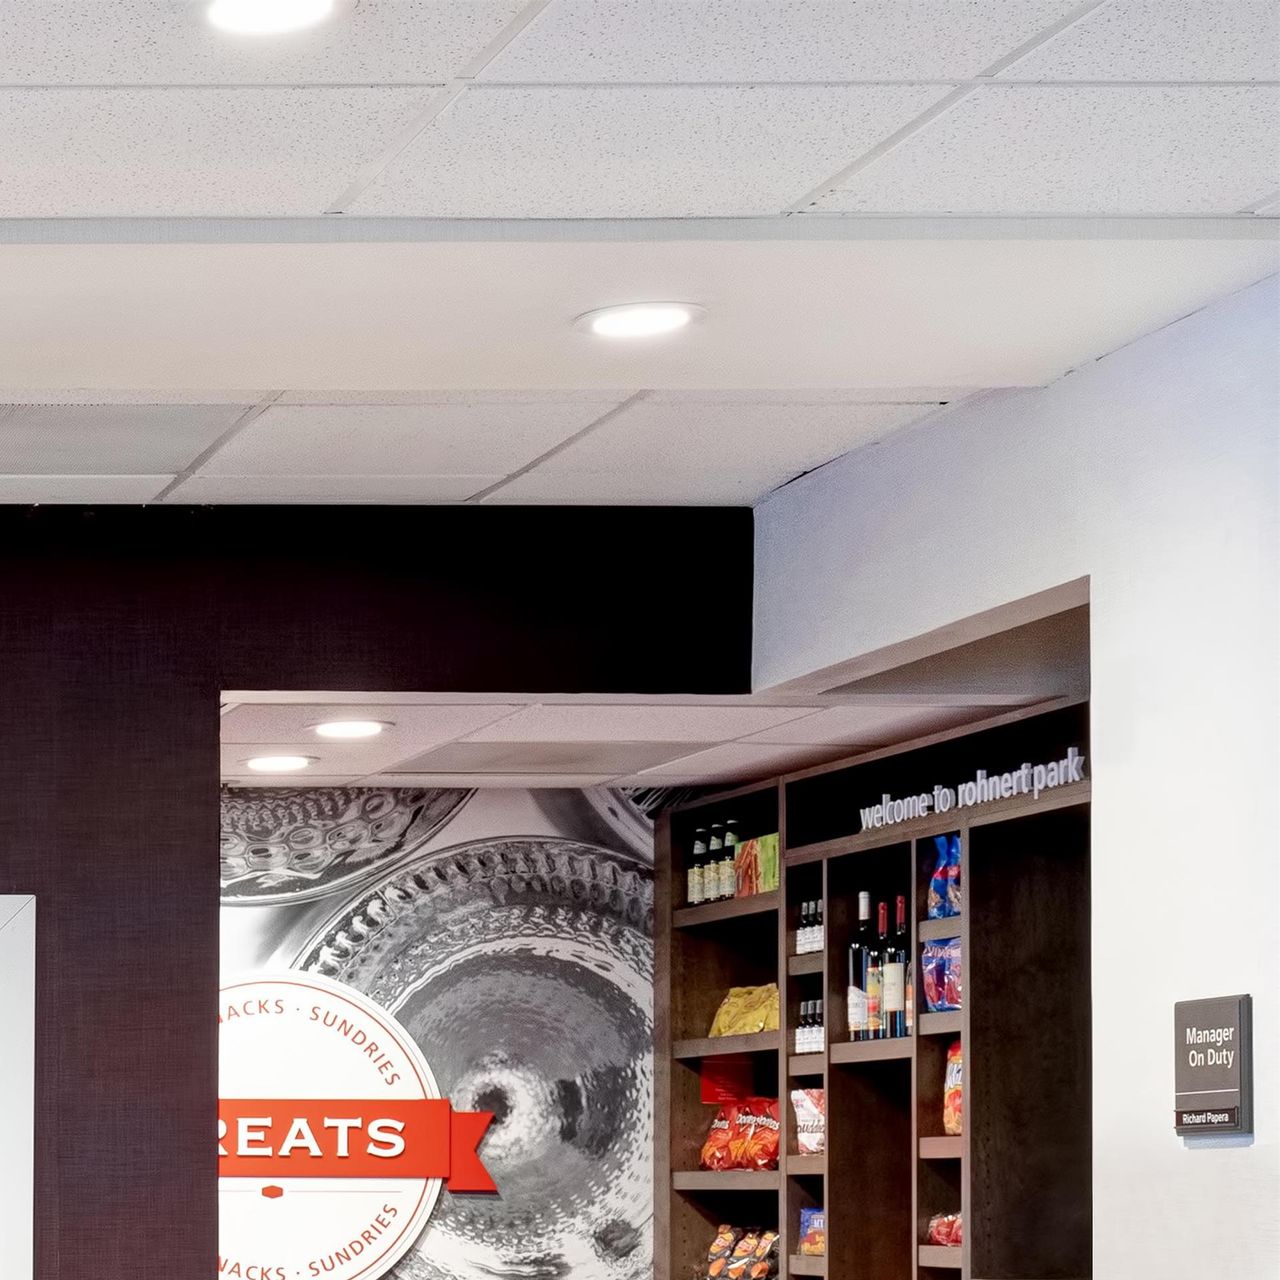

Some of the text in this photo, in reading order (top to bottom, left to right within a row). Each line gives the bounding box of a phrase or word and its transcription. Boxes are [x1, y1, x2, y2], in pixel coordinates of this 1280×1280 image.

[860, 747, 1085, 830] welcome to rohnert park
[309, 1006, 401, 1086] SUNDRIES
[1186, 1027, 1235, 1046] Manager
[1188, 1049, 1235, 1069] On Duty
[1182, 1112, 1206, 1124] Richard
[308, 1203, 399, 1277] SUNDRIES
